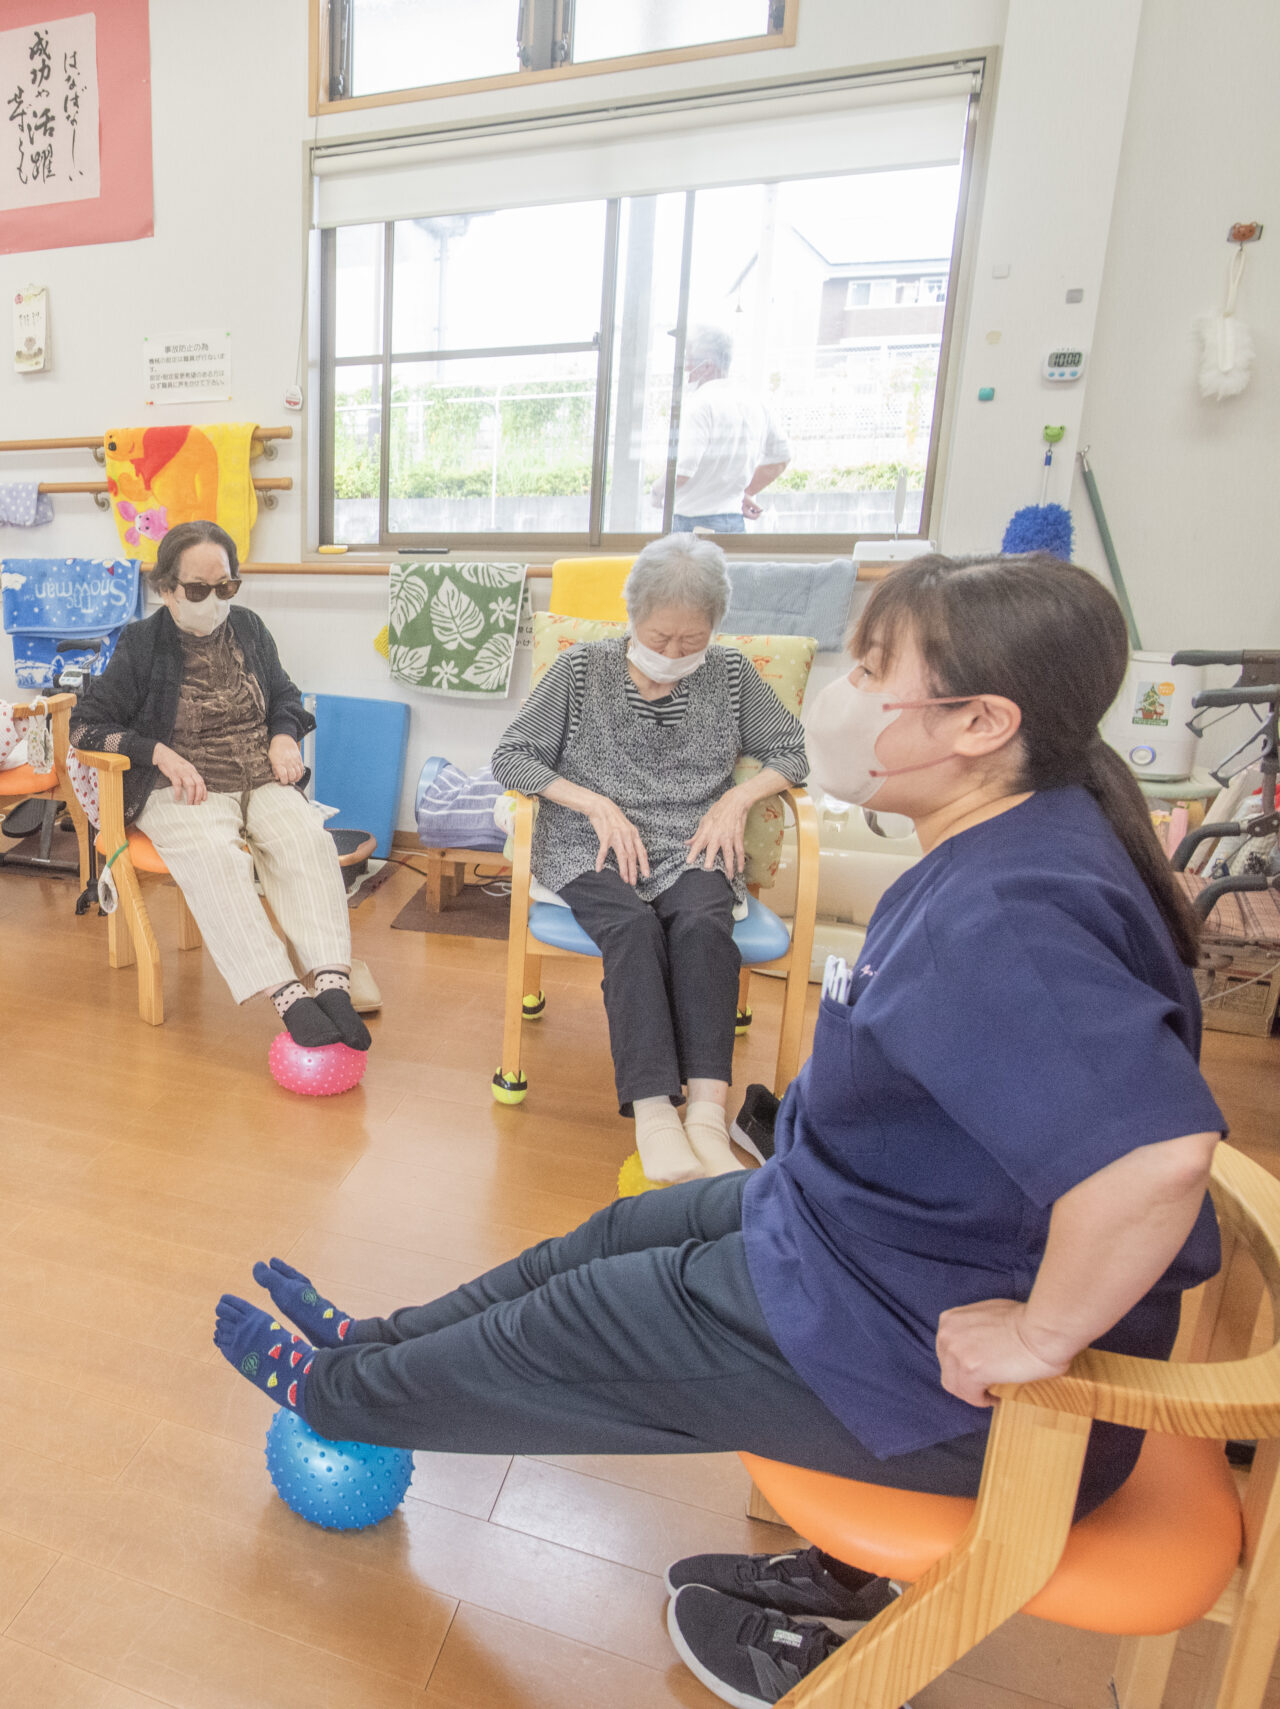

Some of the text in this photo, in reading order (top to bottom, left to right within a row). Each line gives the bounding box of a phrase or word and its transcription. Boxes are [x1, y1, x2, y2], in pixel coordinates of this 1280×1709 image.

[26, 29, 56, 184] 成功や活躍
[34, 578, 127, 606] Snowman
[66, 594, 94, 613] The
